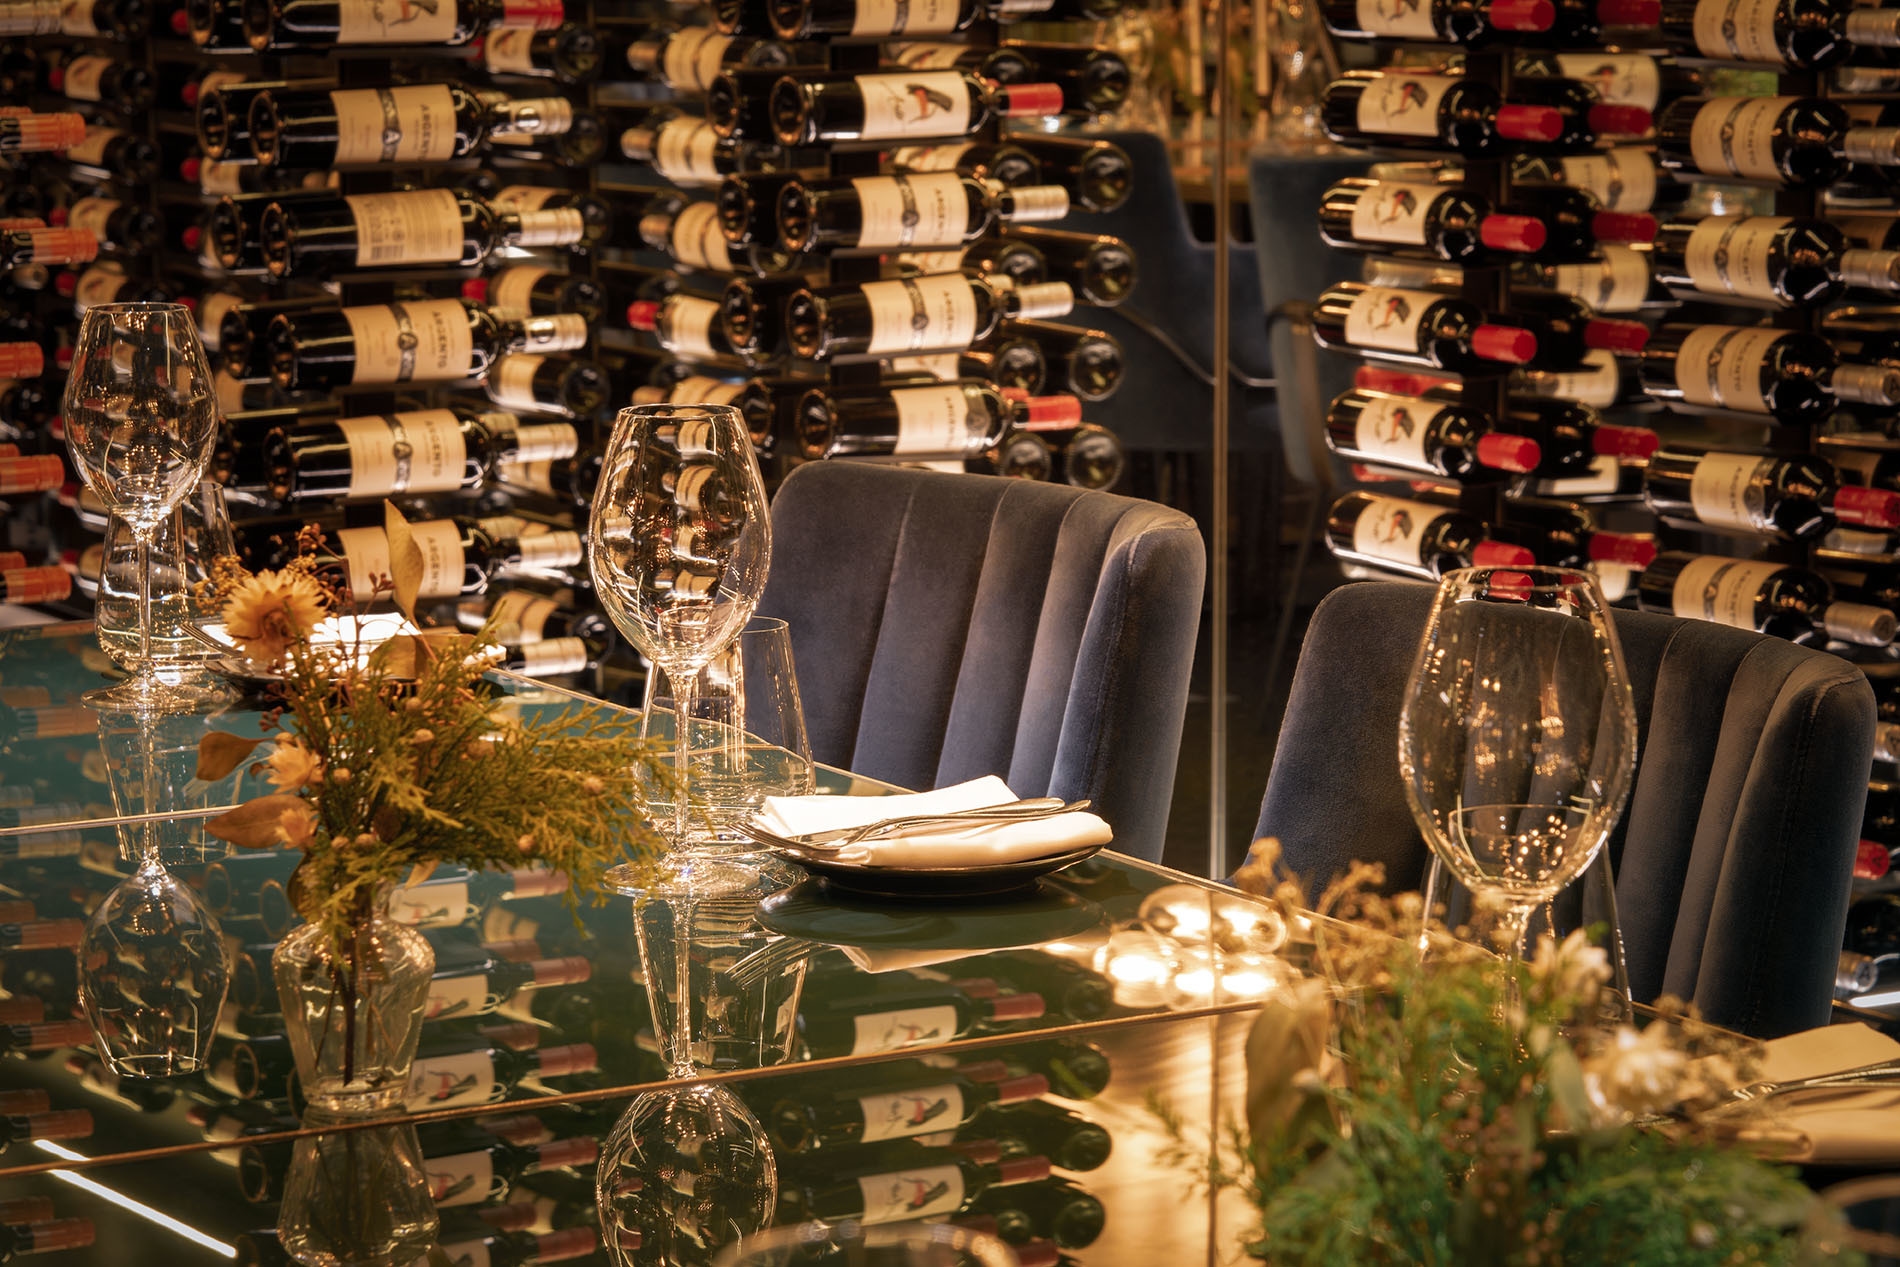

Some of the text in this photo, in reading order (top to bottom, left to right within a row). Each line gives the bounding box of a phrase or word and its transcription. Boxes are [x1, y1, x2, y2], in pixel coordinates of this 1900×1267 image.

[432, 311, 447, 367] ARGENTO
[1734, 335, 1757, 391] ARGENTO
[425, 420, 441, 477] ARGENTO
